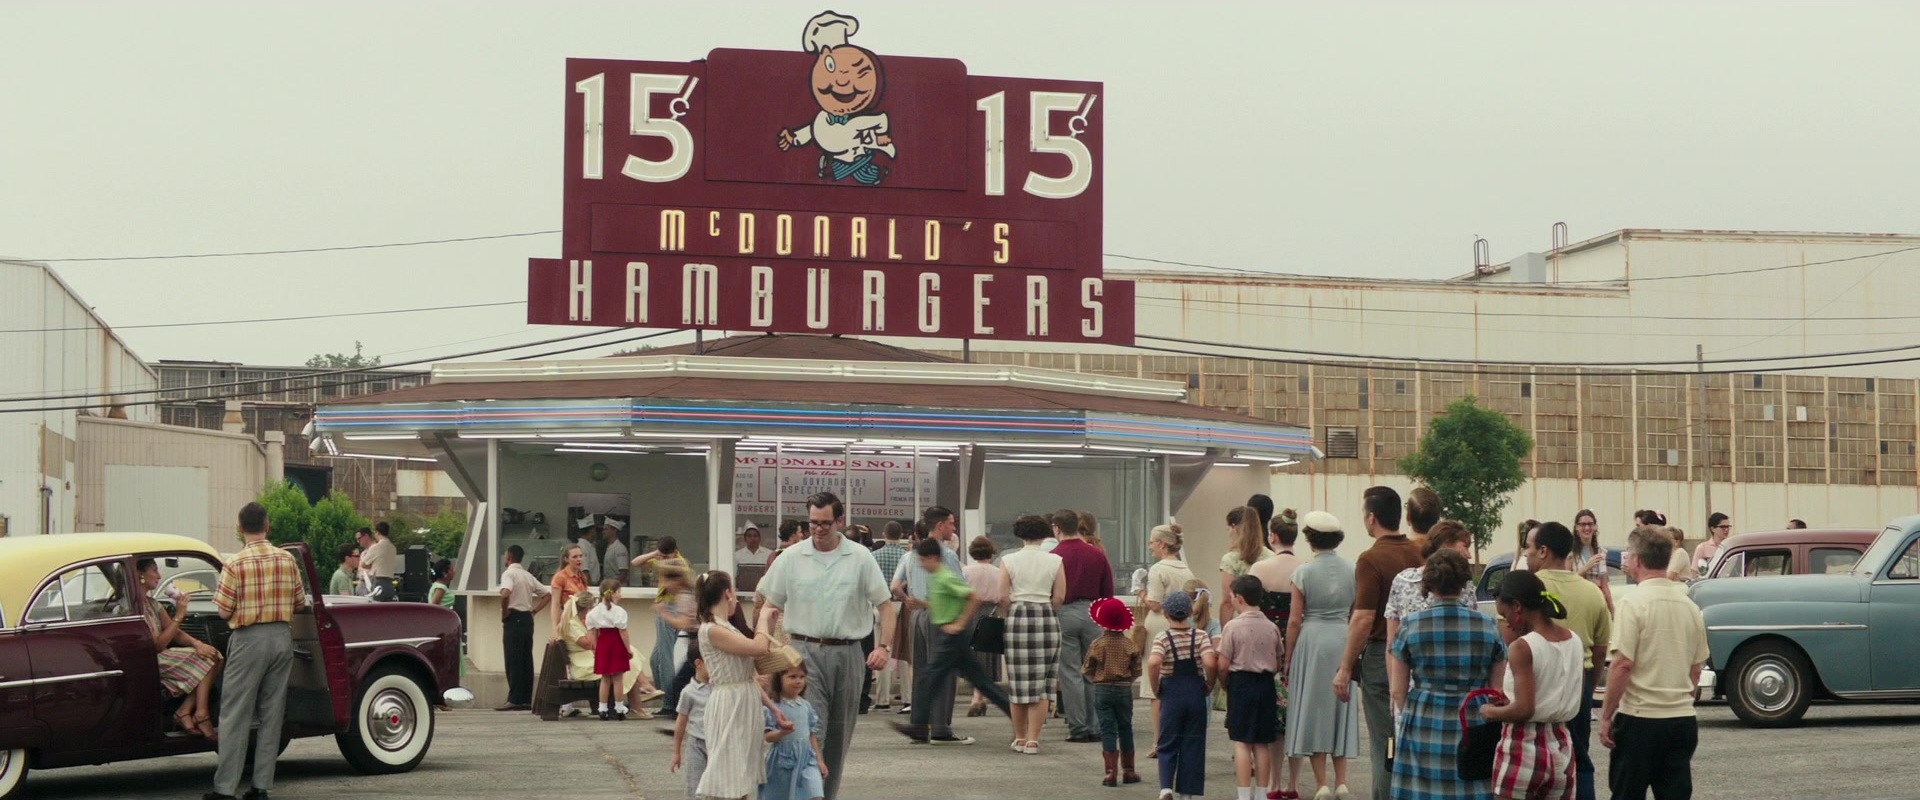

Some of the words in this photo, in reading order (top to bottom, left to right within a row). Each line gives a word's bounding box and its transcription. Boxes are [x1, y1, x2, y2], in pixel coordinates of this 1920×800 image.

[569, 259, 1104, 339] HAMBURGERS
[867, 460, 900, 469] NO.
[840, 487, 863, 496] BEF
[736, 505, 775, 513] BURGERS
[851, 508, 904, 516] ESEBURGERS
